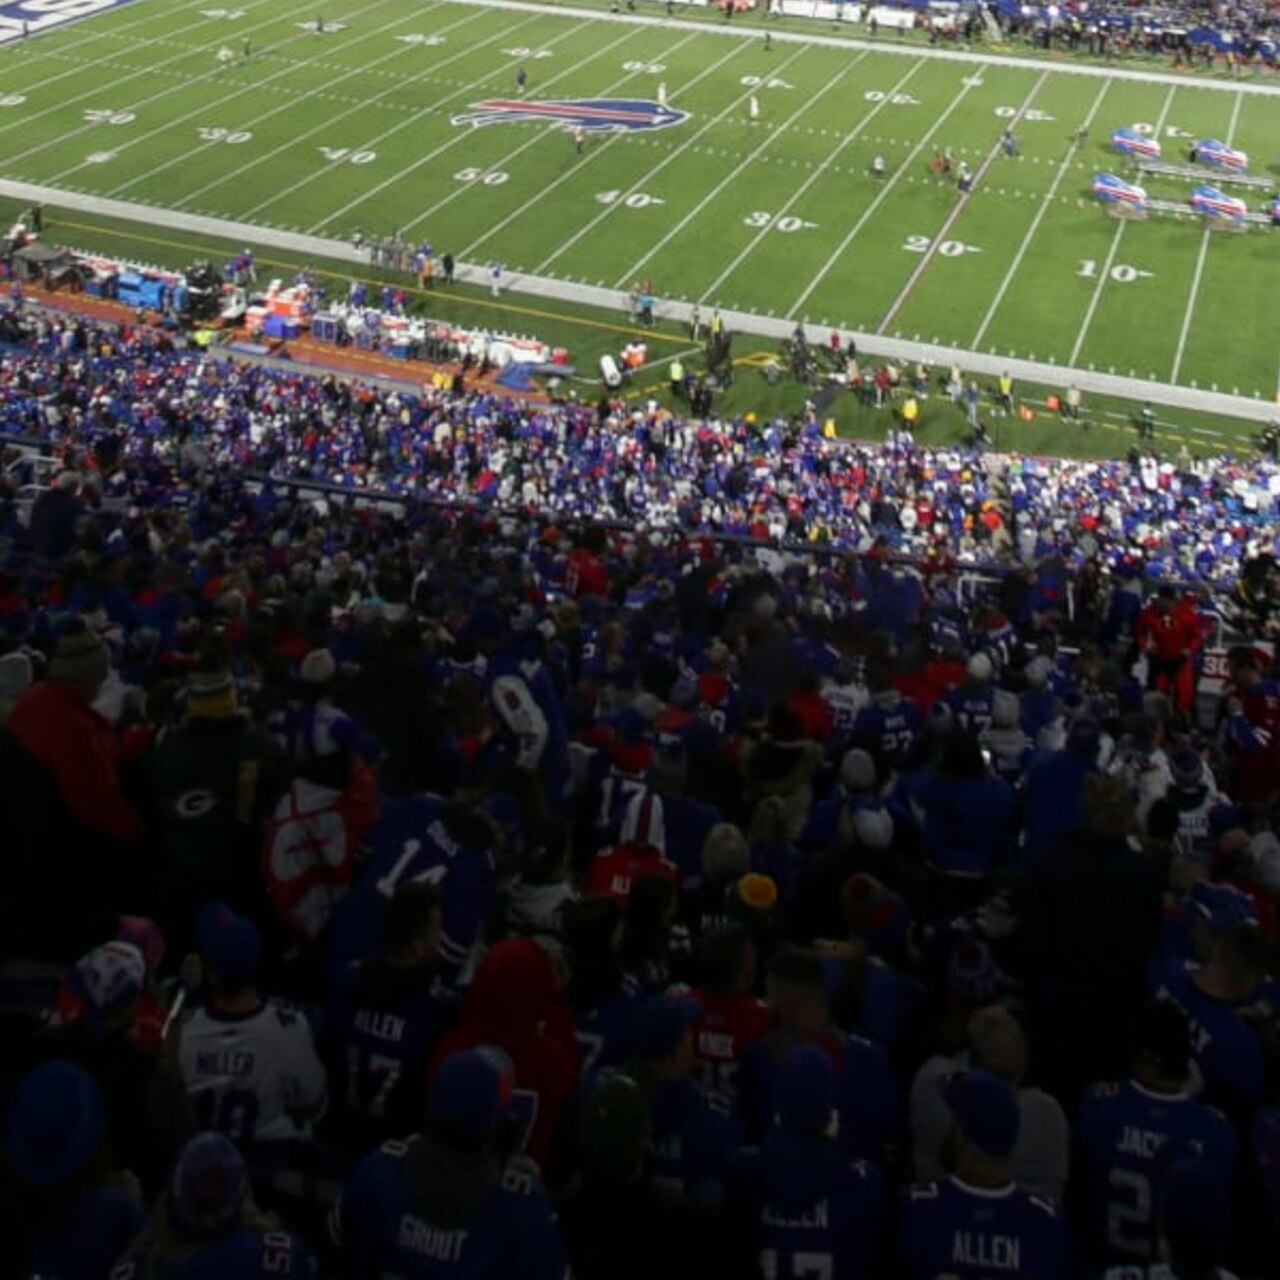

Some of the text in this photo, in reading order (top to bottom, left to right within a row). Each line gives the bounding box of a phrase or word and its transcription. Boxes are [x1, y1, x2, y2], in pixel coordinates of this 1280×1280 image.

[320, 145, 377, 165] 40
[454, 166, 510, 186] 50
[595, 189, 652, 208] 40
[743, 211, 802, 232] 30
[903, 235, 968, 257] 20
[1076, 259, 1140, 283] 10
[175, 789, 217, 818] G
[600, 774, 647, 828] 17
[353, 1007, 407, 1043] ALLEN
[195, 1050, 256, 1078] MILLER
[346, 1042, 402, 1118] 17
[263, 1230, 292, 1275] 50
[952, 1229, 1021, 1270] ALLEN
